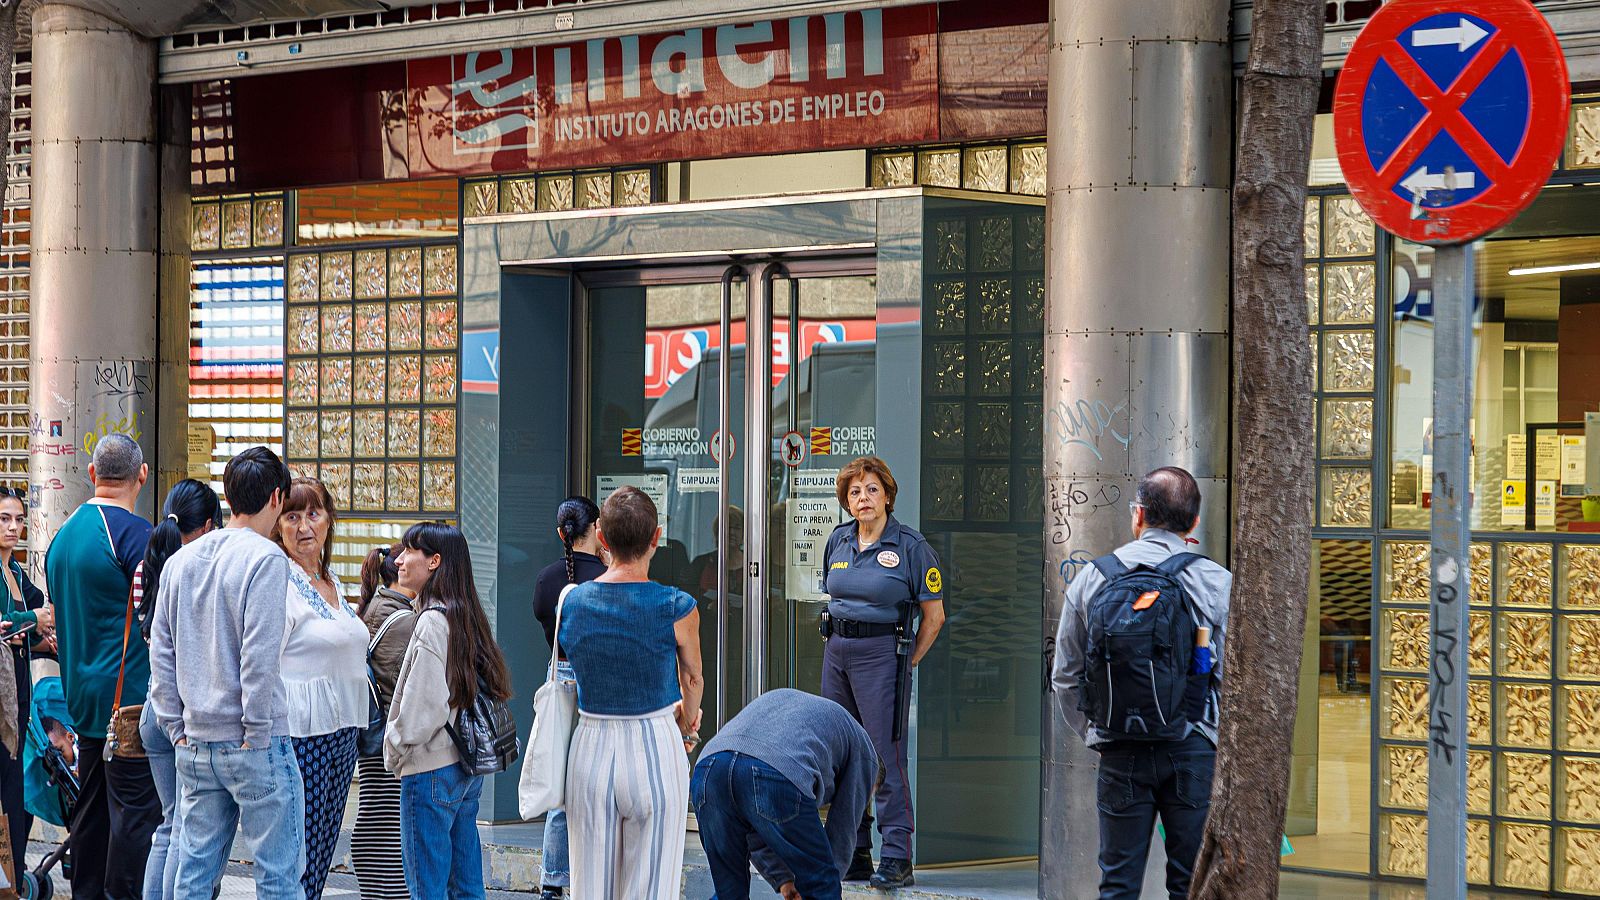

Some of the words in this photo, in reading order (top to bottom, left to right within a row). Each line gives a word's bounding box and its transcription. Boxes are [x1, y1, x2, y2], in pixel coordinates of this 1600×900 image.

[554, 9, 884, 104] inaem
[554, 110, 650, 141] INSTITUTO
[655, 101, 764, 133] ARAGONES
[770, 98, 796, 124] DE
[802, 90, 885, 121] EMPLEO
[642, 428, 700, 441] GOBIERNO
[642, 442, 658, 455] DE
[660, 441, 709, 455] ARAGON
[832, 441, 848, 455] DE
[794, 477, 835, 486] EMPUJAR
[799, 503, 827, 511] SOLICITA
[793, 516, 809, 524] CITA
[809, 516, 833, 524] PREVIA
[803, 528, 823, 537] PARA:
[794, 542, 813, 550] INAEM
